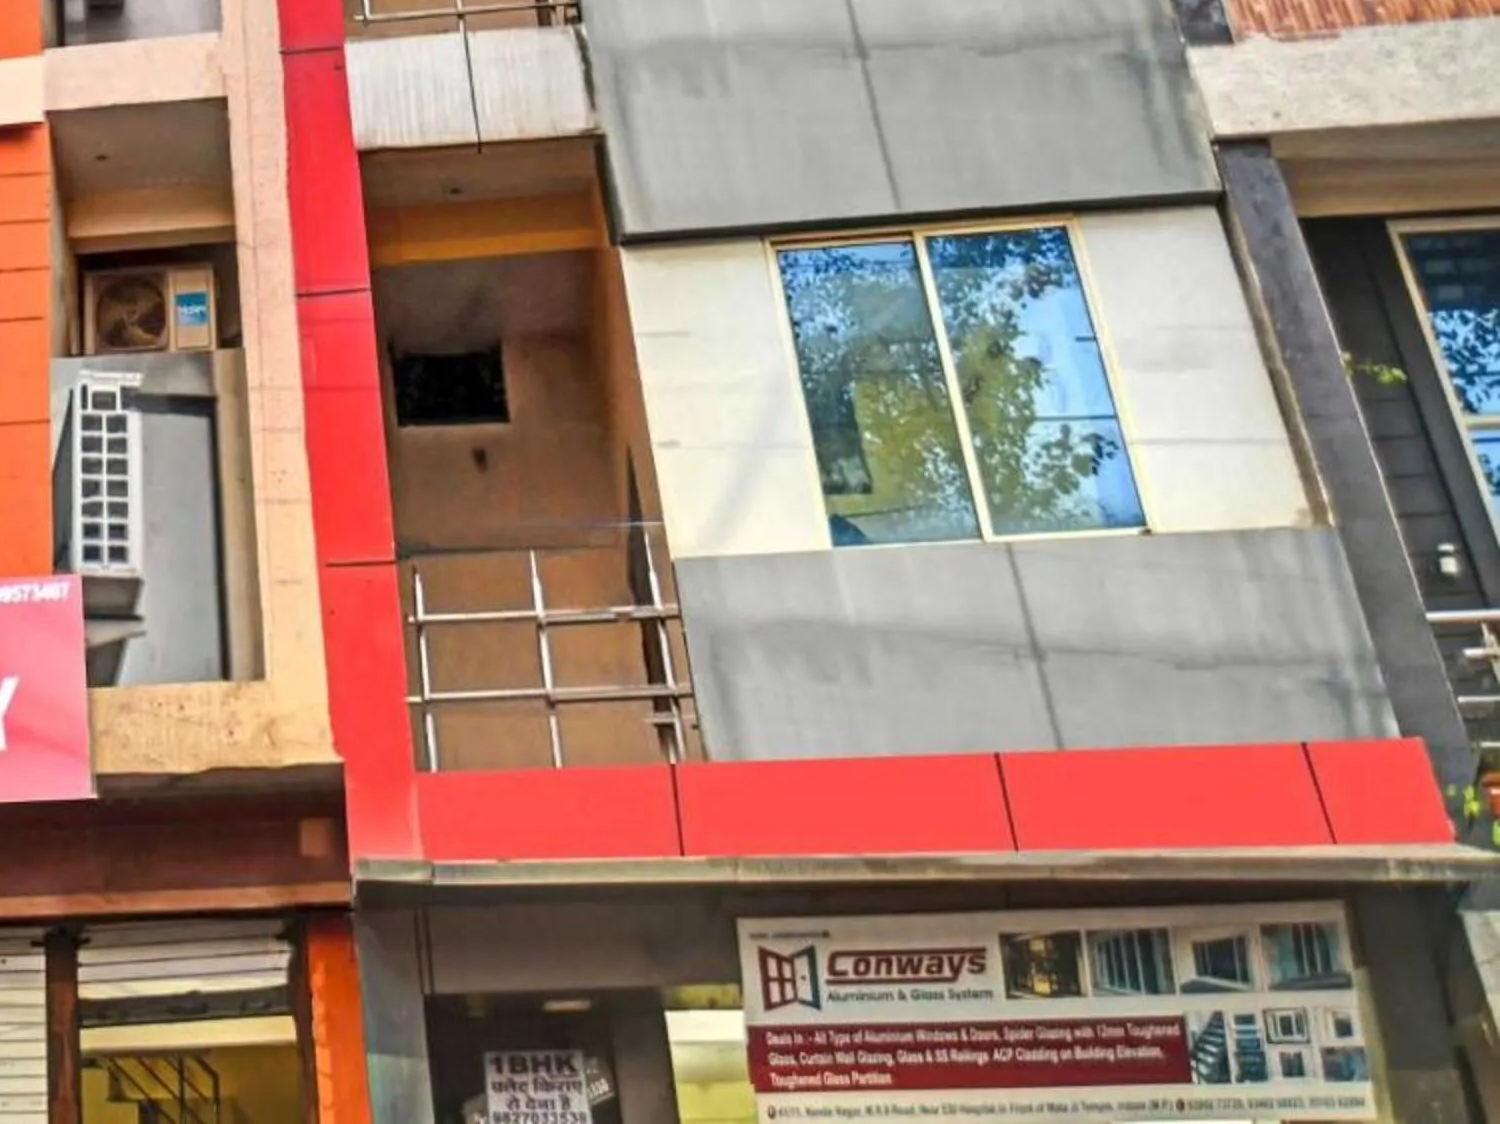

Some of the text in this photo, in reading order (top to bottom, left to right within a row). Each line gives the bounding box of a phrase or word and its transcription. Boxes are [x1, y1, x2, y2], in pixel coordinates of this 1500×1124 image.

[826, 947, 986, 984] Conways
[826, 989, 894, 1002] Aluminium
[910, 988, 945, 1001] Glass
[948, 987, 993, 1001] System
[489, 1054, 578, 1075] 1BHK
